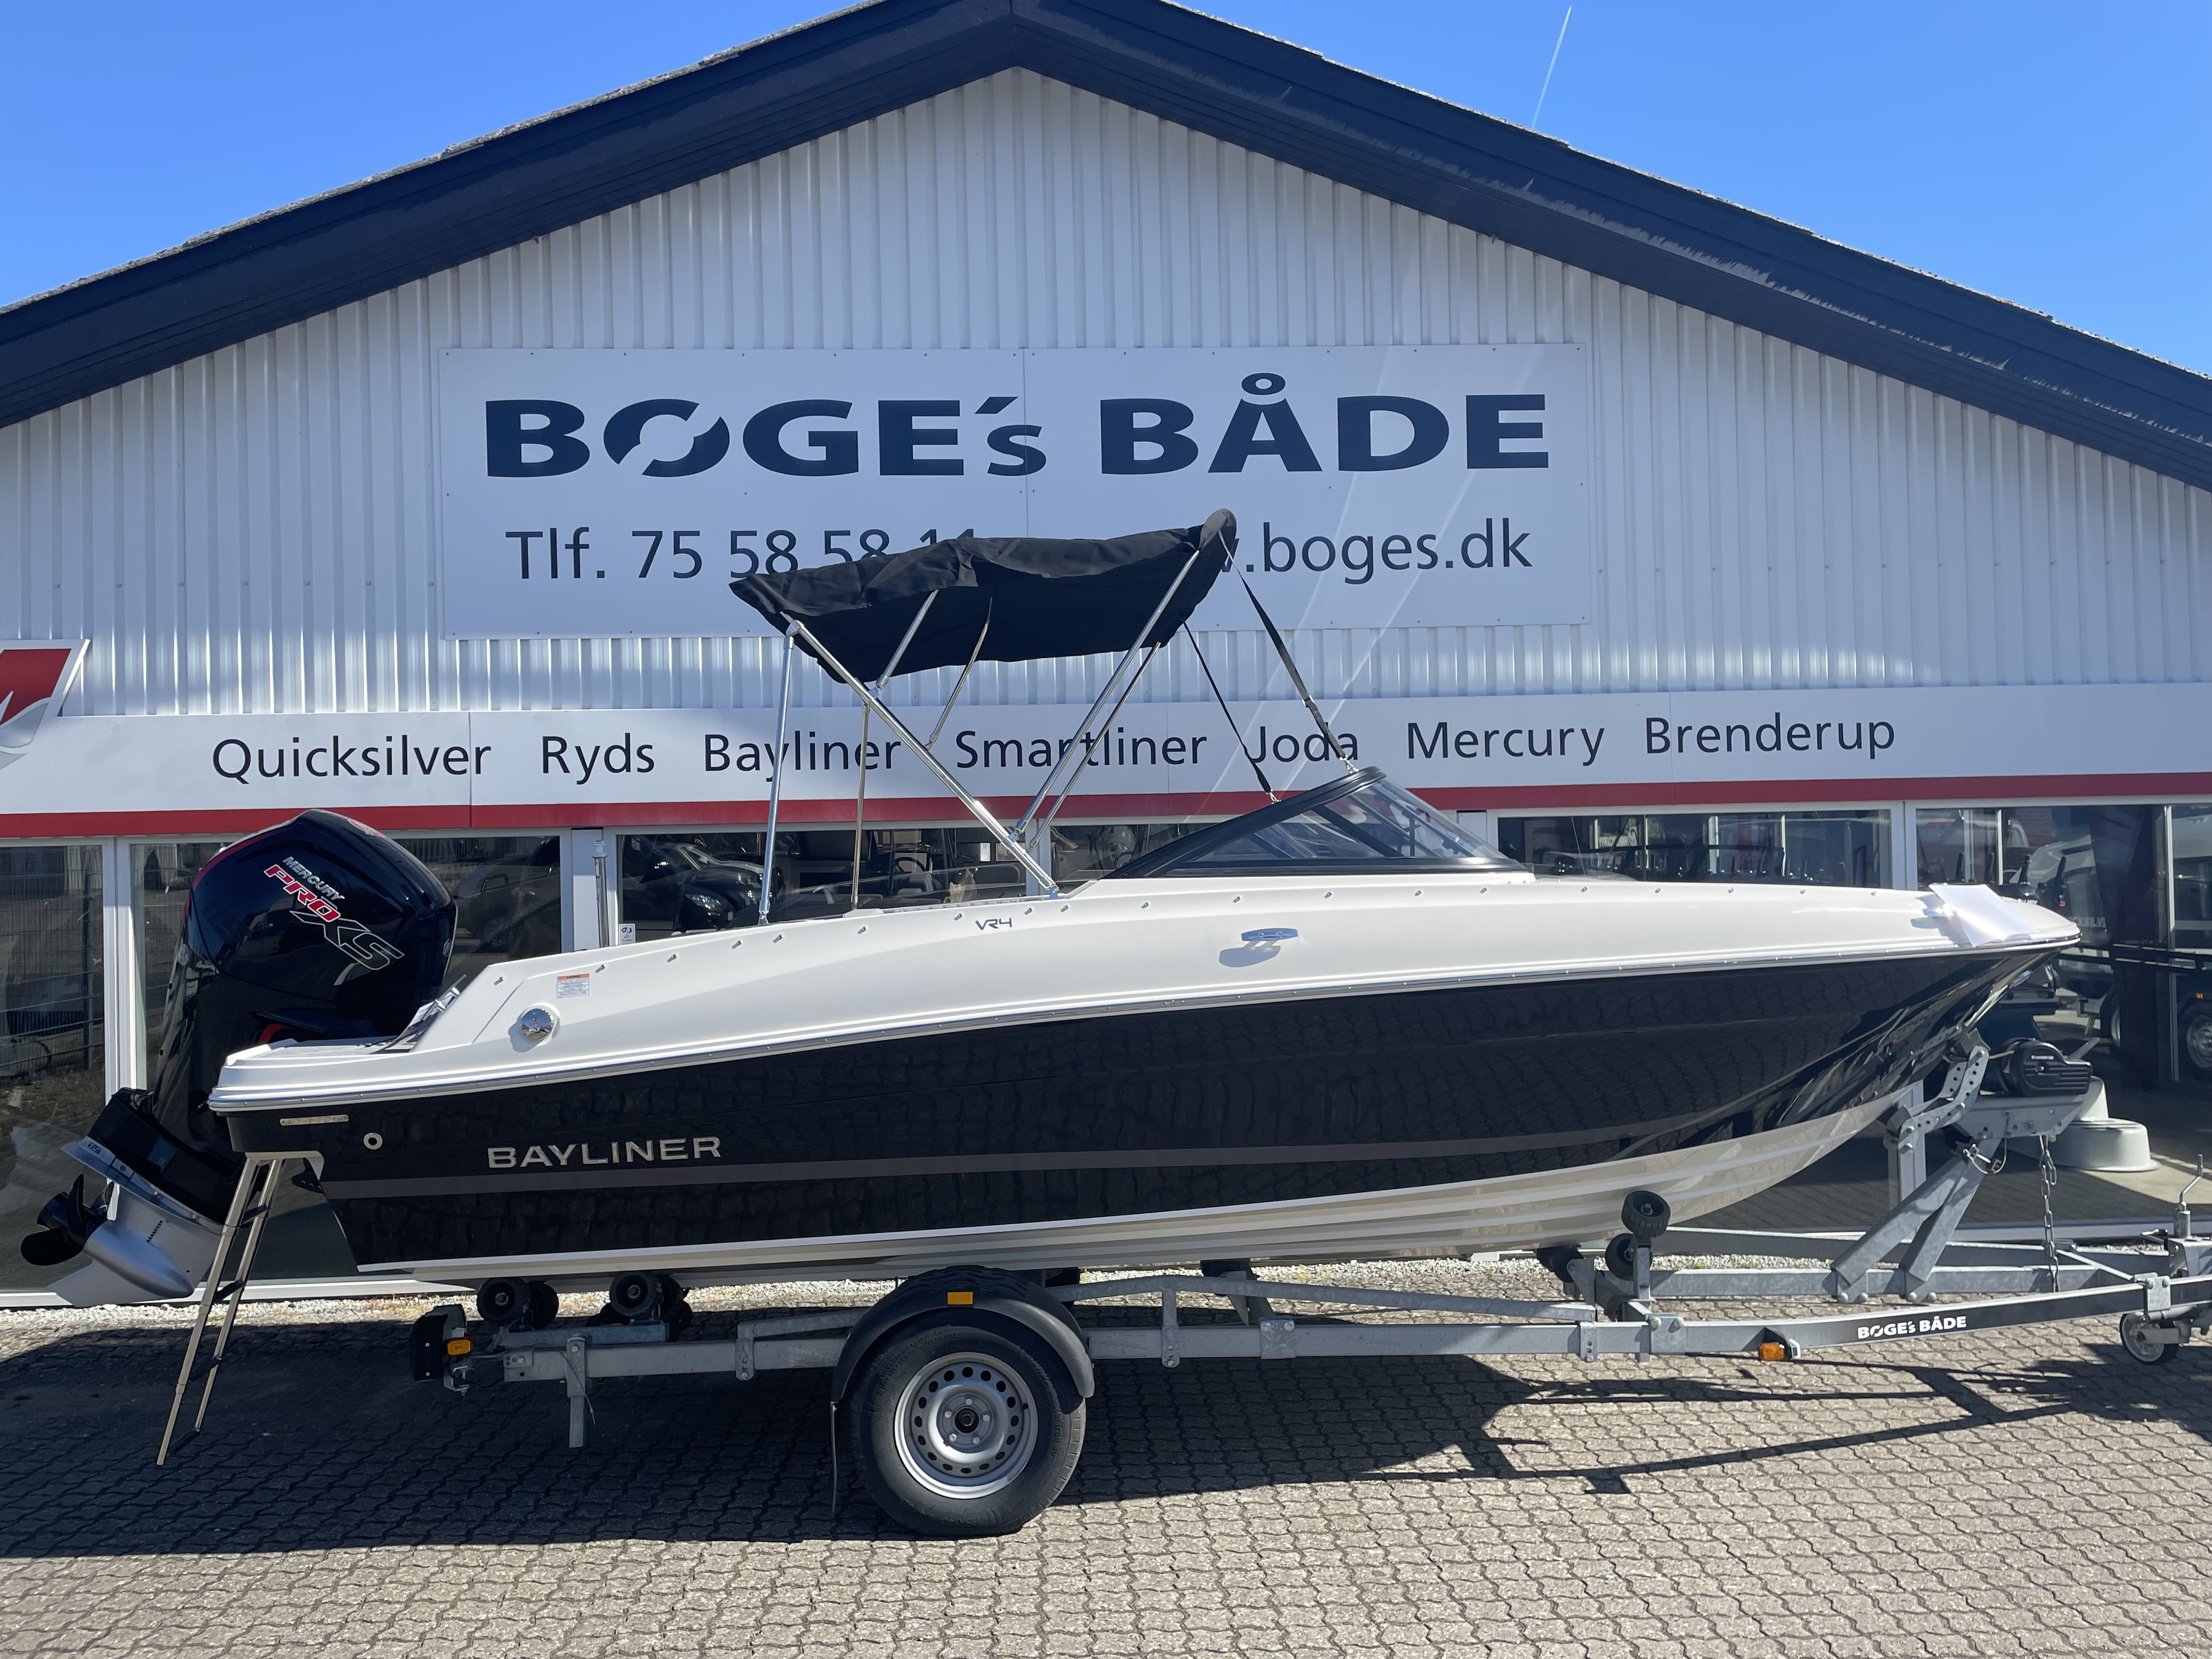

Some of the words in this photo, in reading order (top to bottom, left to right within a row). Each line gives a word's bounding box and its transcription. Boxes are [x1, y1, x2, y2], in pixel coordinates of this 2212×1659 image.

[1101, 373, 1549, 475] BÅDE
[506, 527, 605, 579] Tlf.
[632, 531, 702, 578] 75
[731, 529, 798, 578] 58
[213, 735, 492, 784] Quicksilver
[542, 733, 654, 785] Ryds
[705, 731, 901, 782] Bayliner
[956, 727, 1207, 769] Smartliner
[1250, 722, 1358, 763] Joda
[1408, 722, 1605, 766] Mercury
[1646, 712, 1894, 759] Brenderup
[263, 864, 341, 922] PRO
[283, 856, 345, 901] MERCURY
[290, 896, 405, 970] XS
[975, 917, 1012, 930] VR4
[488, 1136, 721, 1169] BAYLINER
[1919, 1316, 1967, 1332] BÅDE
